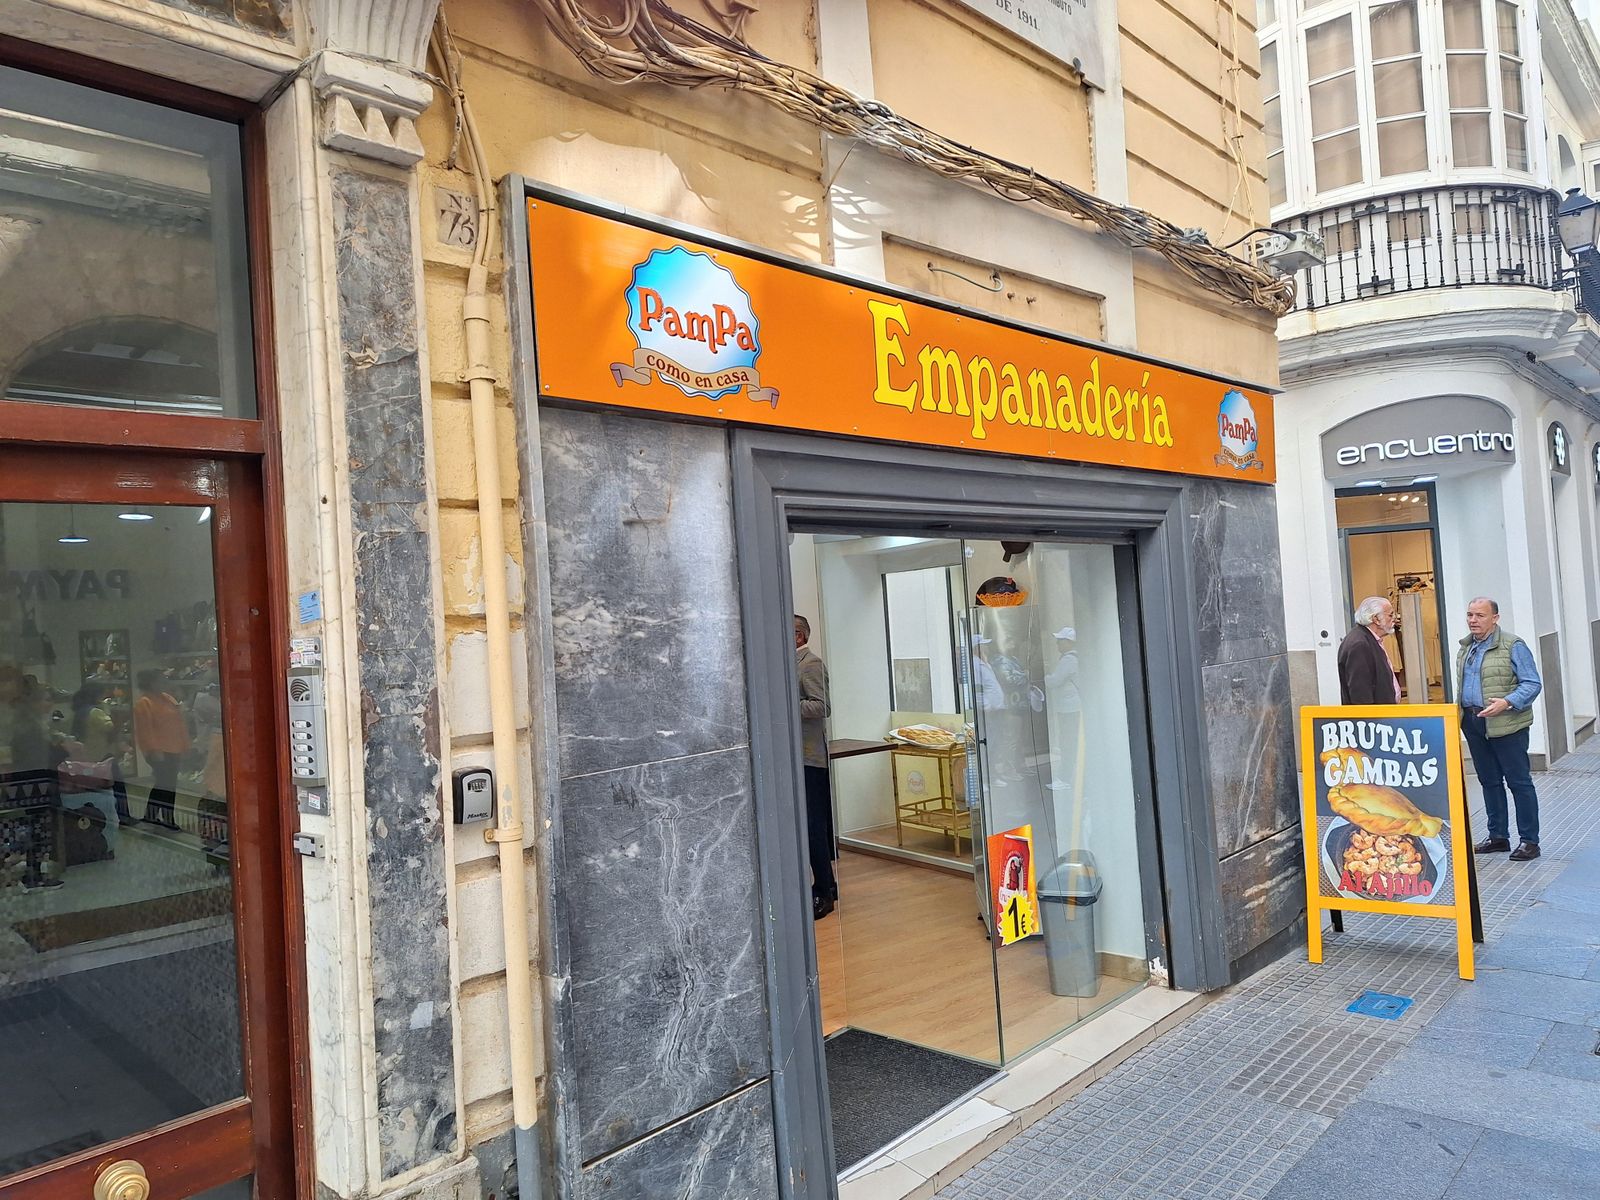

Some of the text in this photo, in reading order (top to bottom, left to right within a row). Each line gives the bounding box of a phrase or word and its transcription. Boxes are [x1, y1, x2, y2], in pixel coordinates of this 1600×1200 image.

[440, 209, 475, 246] 75
[636, 286, 757, 354] PamPa
[646, 354, 750, 388] como en casa
[867, 299, 1174, 448] Empanadería
[1221, 413, 1257, 445] PamPa
[1336, 430, 1515, 466] encuentro
[1321, 720, 1428, 755] BRUTAL
[1324, 755, 1439, 788] GAMBAS
[1337, 870, 1433, 899] Al Ajillo
